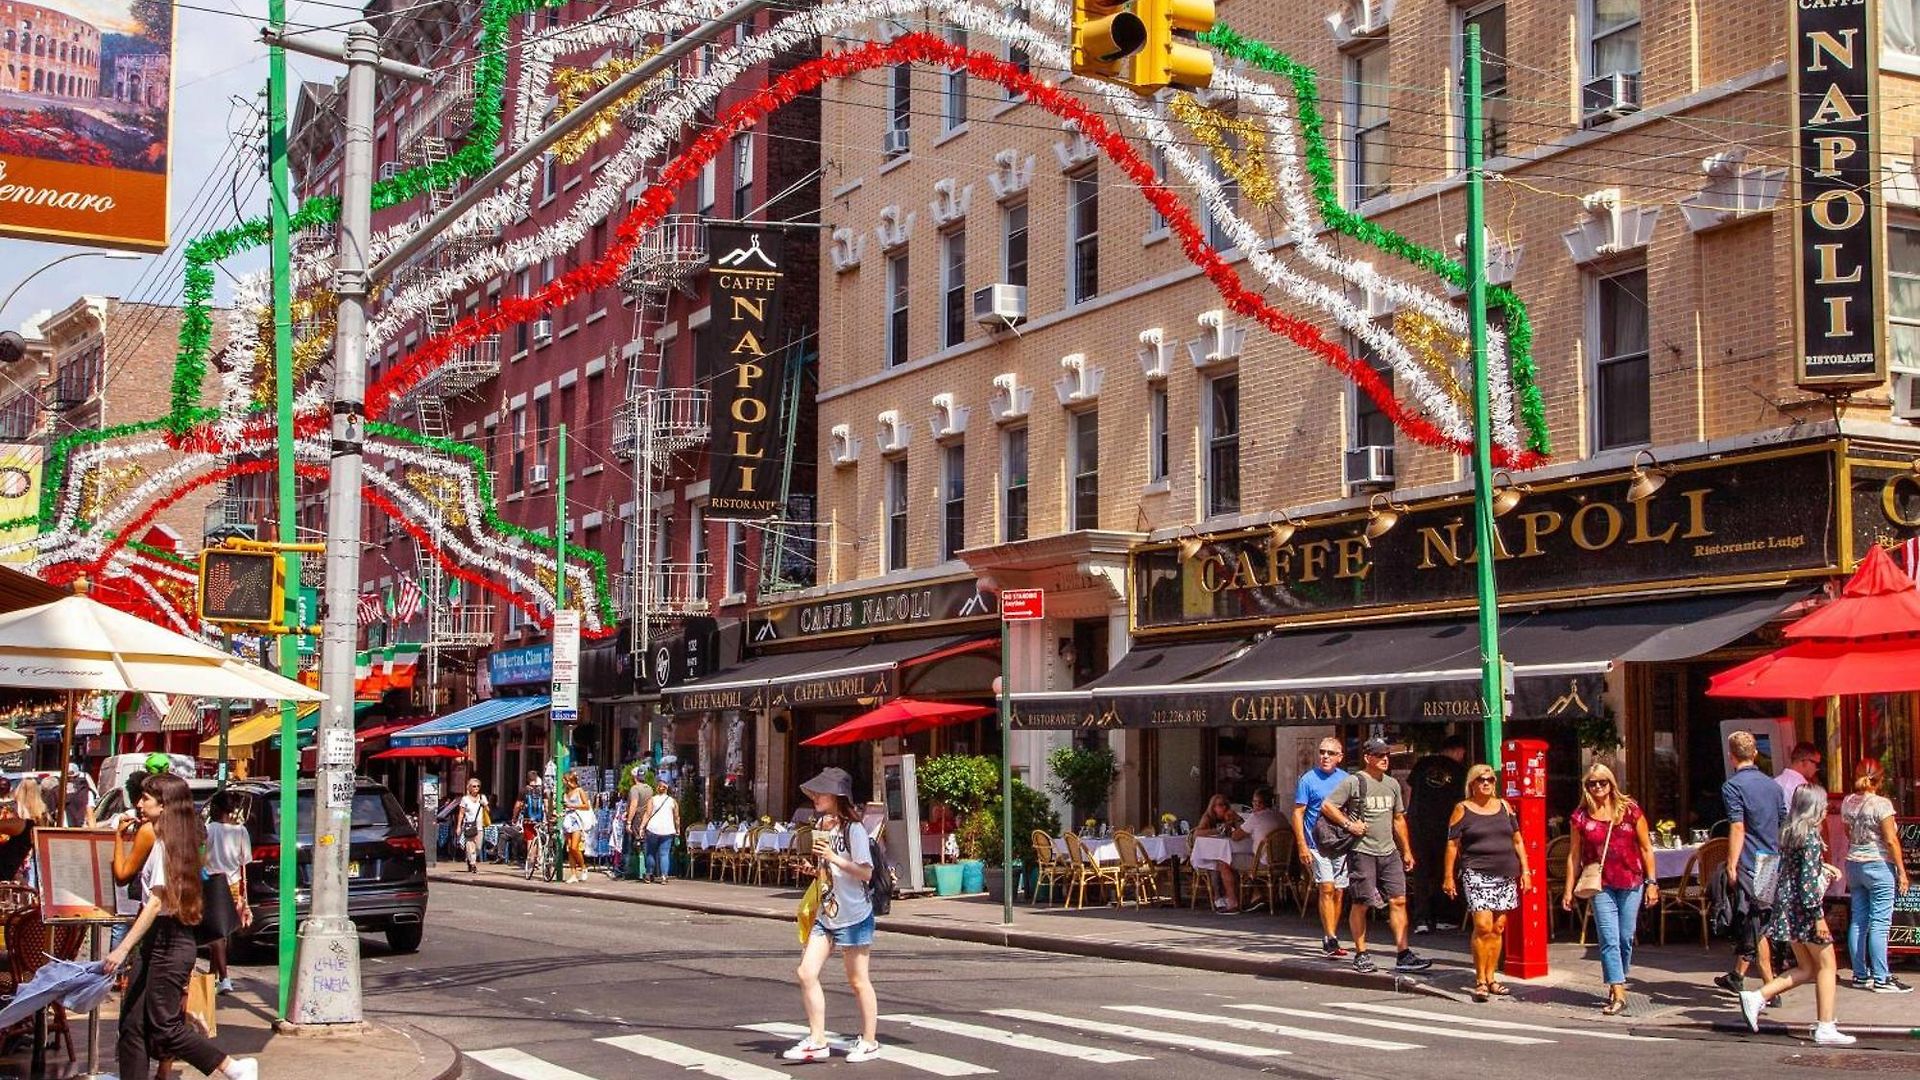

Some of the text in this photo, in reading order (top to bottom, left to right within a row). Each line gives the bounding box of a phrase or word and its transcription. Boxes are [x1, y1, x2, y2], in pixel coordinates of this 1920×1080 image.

[1806, 28, 1865, 338] NAPOLI
[0, 184, 116, 213] ennaro
[720, 275, 776, 291] CAFFE
[1805, 353, 1874, 365] RISTORANTE
[730, 295, 767, 492] NAPOLI
[1200, 487, 1716, 593] CAFFE NAPOLI
[1693, 534, 1806, 558] Ristorante Luigi
[800, 591, 932, 633] CAFFE NAPOLI
[682, 691, 743, 710] CAFFE NAPOLI
[794, 676, 866, 702] CAFFE NAPOLI
[1231, 690, 1388, 721] CAFFE NAPOLI
[1423, 700, 1484, 717] RISTORA
[1028, 713, 1077, 726] RISTORANTE
